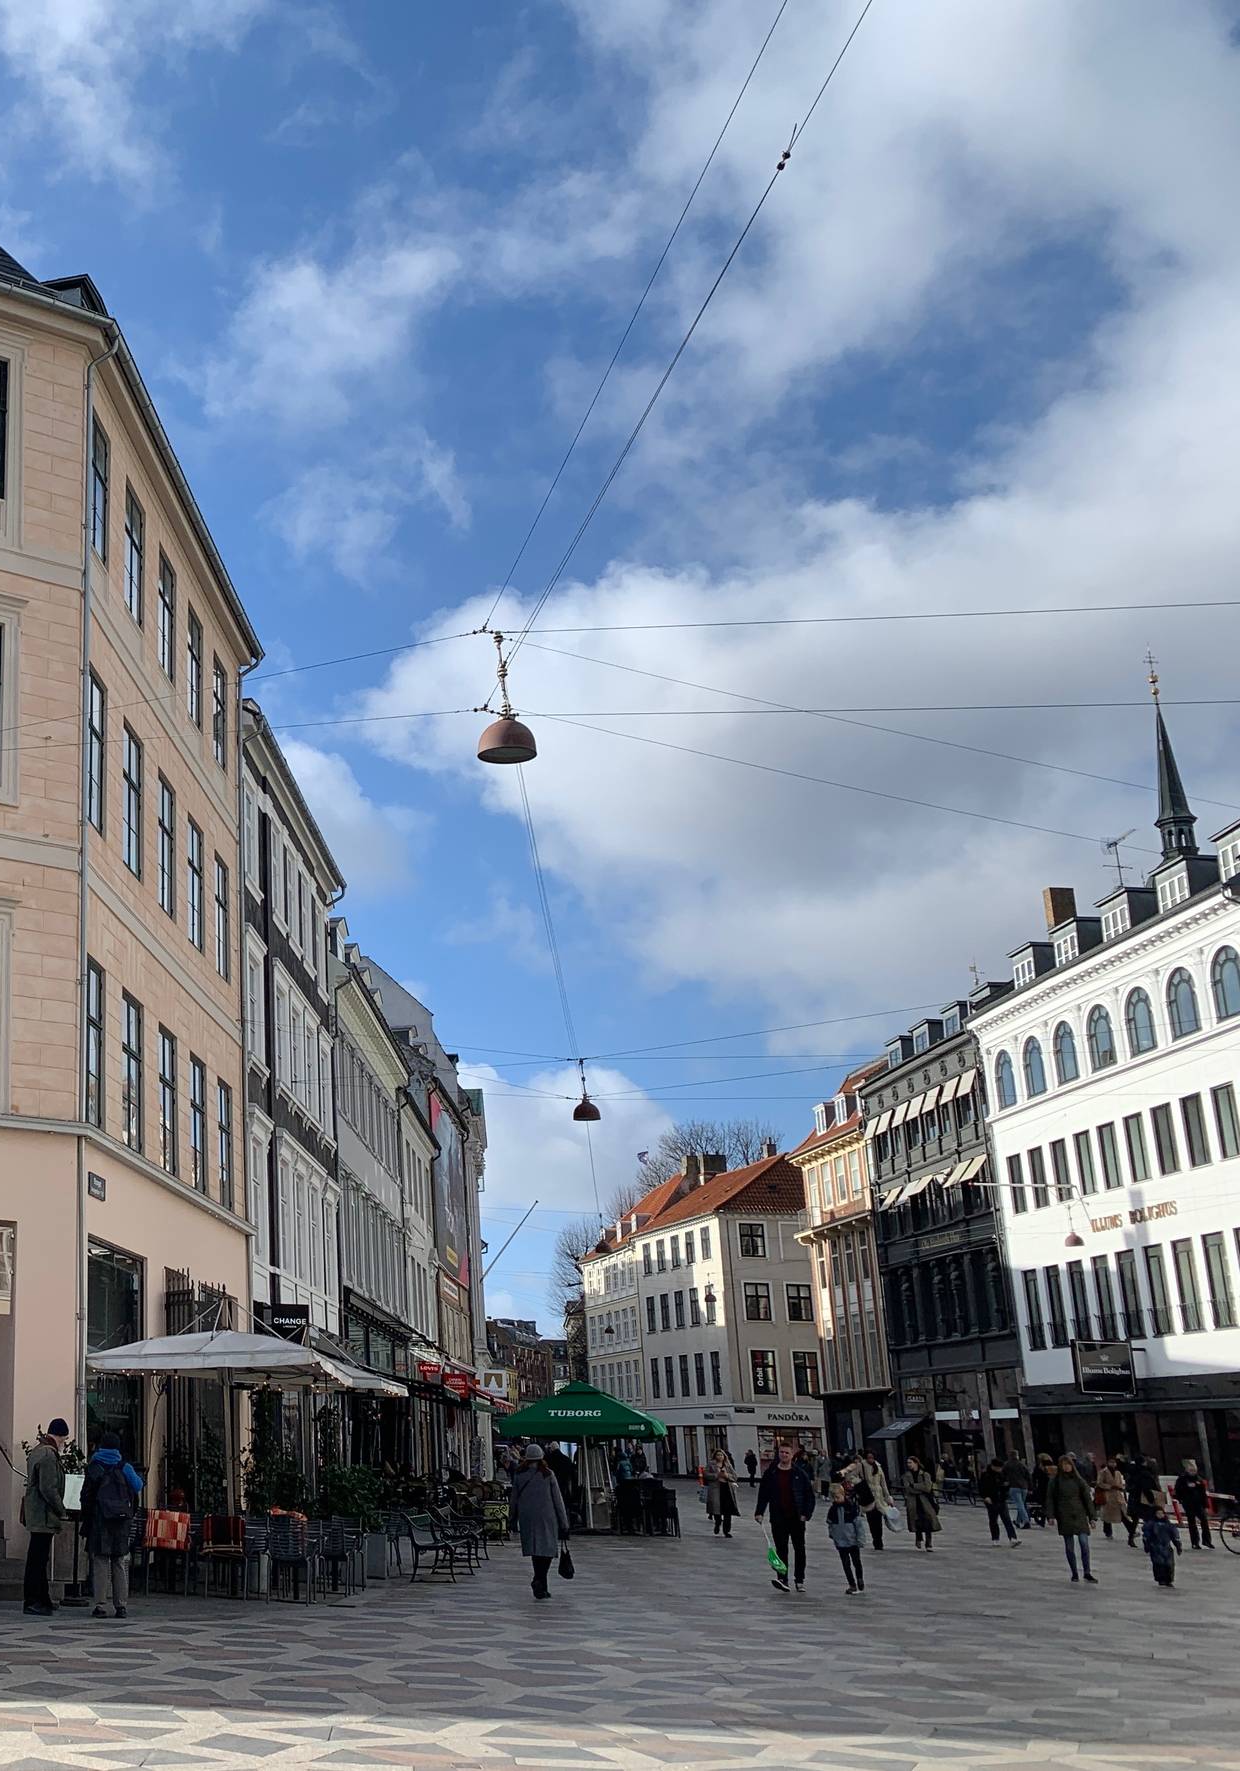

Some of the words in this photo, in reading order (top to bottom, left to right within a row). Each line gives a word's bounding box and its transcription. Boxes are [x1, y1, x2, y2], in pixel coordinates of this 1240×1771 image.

[1090, 1213, 1123, 1233] ILLUMS
[1128, 1200, 1178, 1225] BOLIGHUS
[273, 1317, 307, 1325] CHANGE
[756, 1367, 764, 1387] Orbit
[767, 1412, 810, 1422] PANDORA
